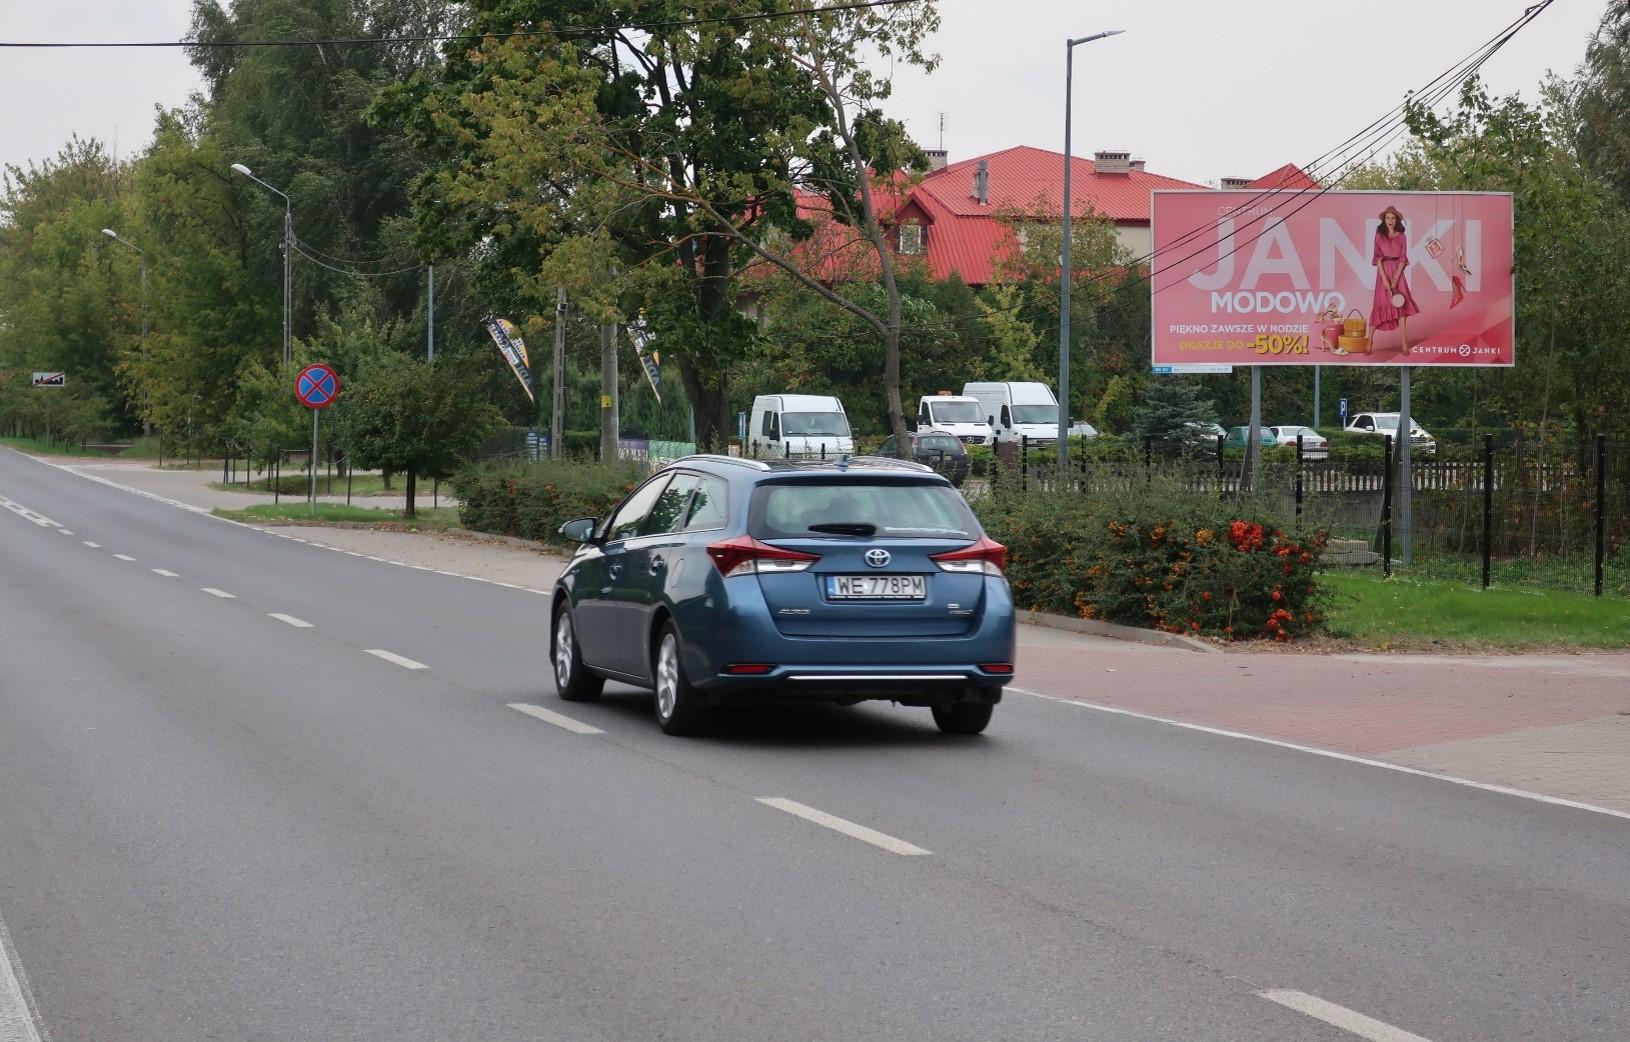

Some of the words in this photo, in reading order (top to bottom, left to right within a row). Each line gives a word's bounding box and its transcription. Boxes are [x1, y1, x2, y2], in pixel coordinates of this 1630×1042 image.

[1217, 206, 1273, 216] CENTRUM
[1187, 217, 1482, 292] JANKI
[1211, 291, 1345, 314] MODOWO
[1170, 324, 1209, 335] PIĘKNO
[1210, 324, 1254, 333] ZAWSZE
[1256, 324, 1268, 333] W
[1270, 324, 1309, 333] NODZIE
[1180, 340, 1225, 350] OKAZJE
[1227, 340, 1244, 350] DO
[1247, 335, 1310, 354] -50%!
[1412, 346, 1457, 354] CENTRUM
[837, 577, 863, 594] WE
[869, 577, 924, 594] 778PM
